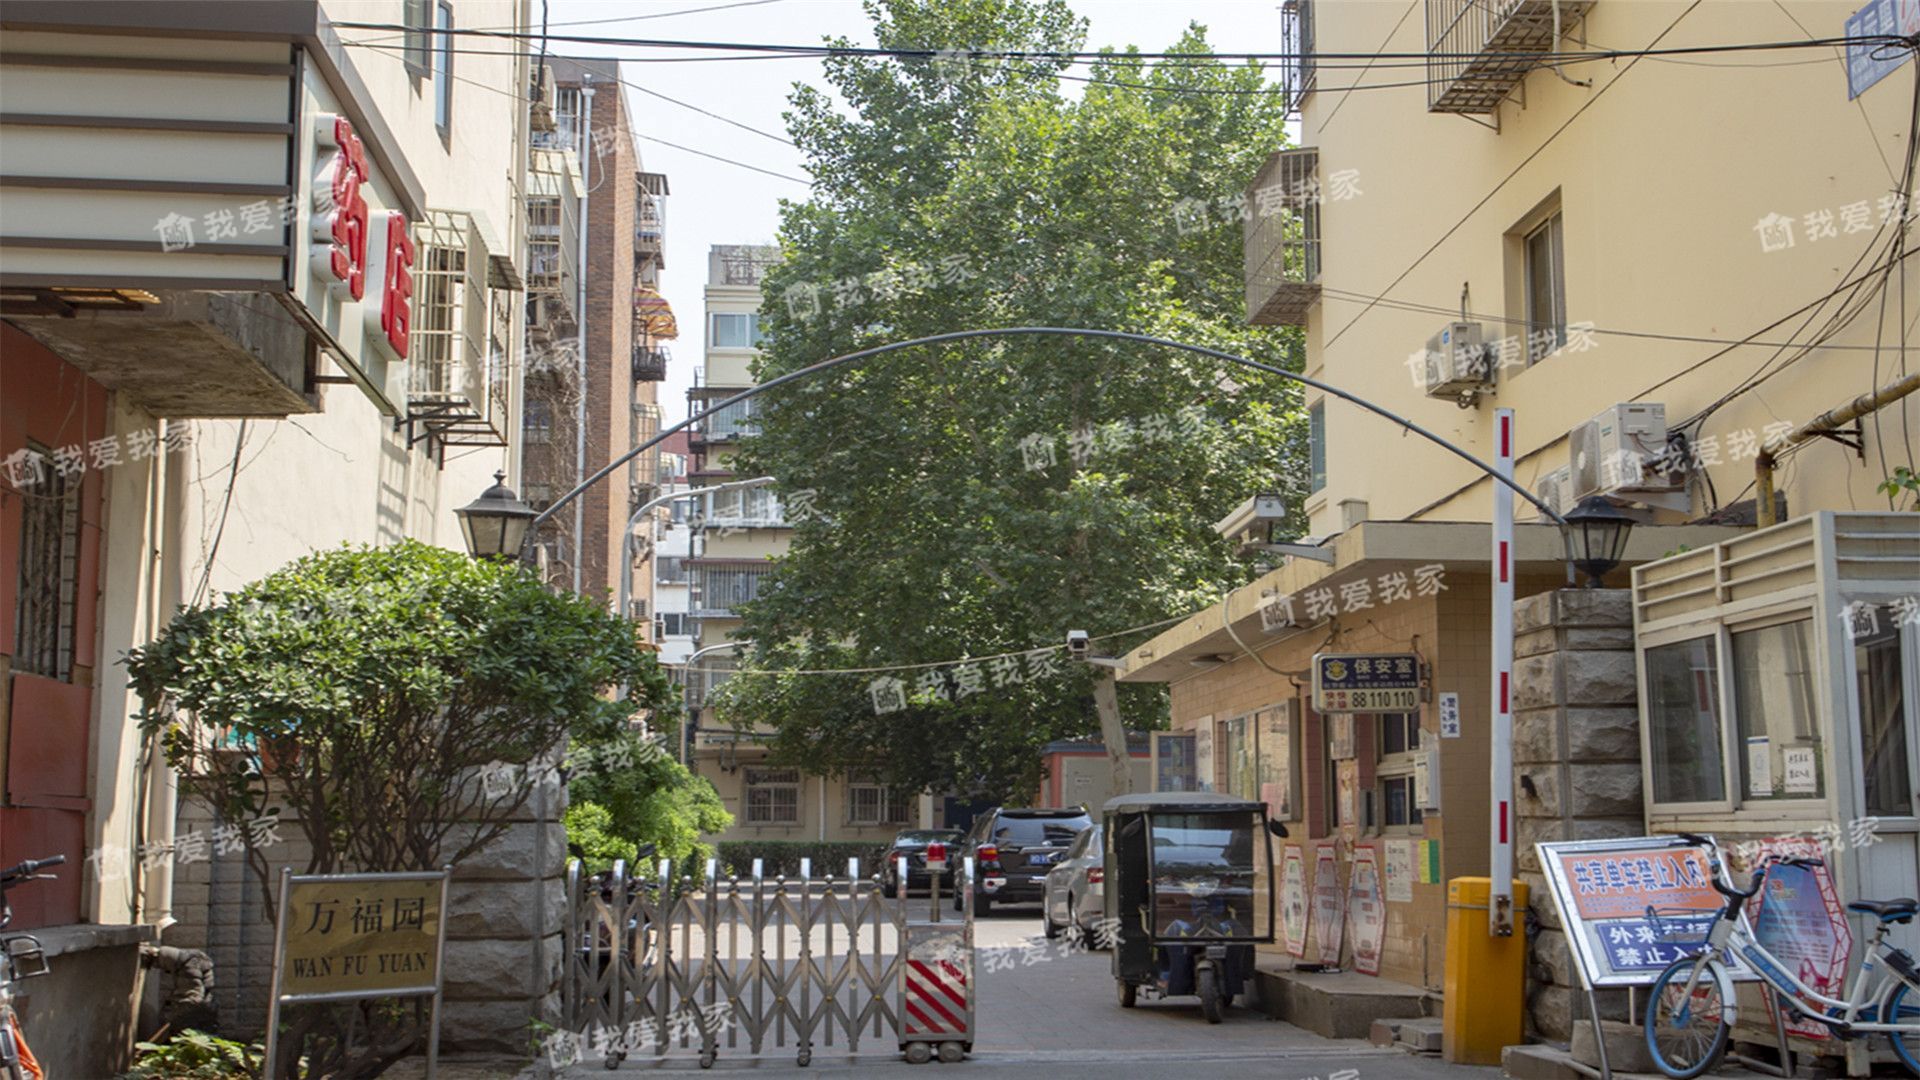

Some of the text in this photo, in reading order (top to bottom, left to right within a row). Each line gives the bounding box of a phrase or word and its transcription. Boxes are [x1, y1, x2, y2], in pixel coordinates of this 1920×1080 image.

[1354, 658, 1413, 675] 保安室
[1573, 855, 1707, 895] 共享单车禁止入内
[304, 897, 425, 935] 万福园
[293, 952, 428, 979] WAN FU YUAN
